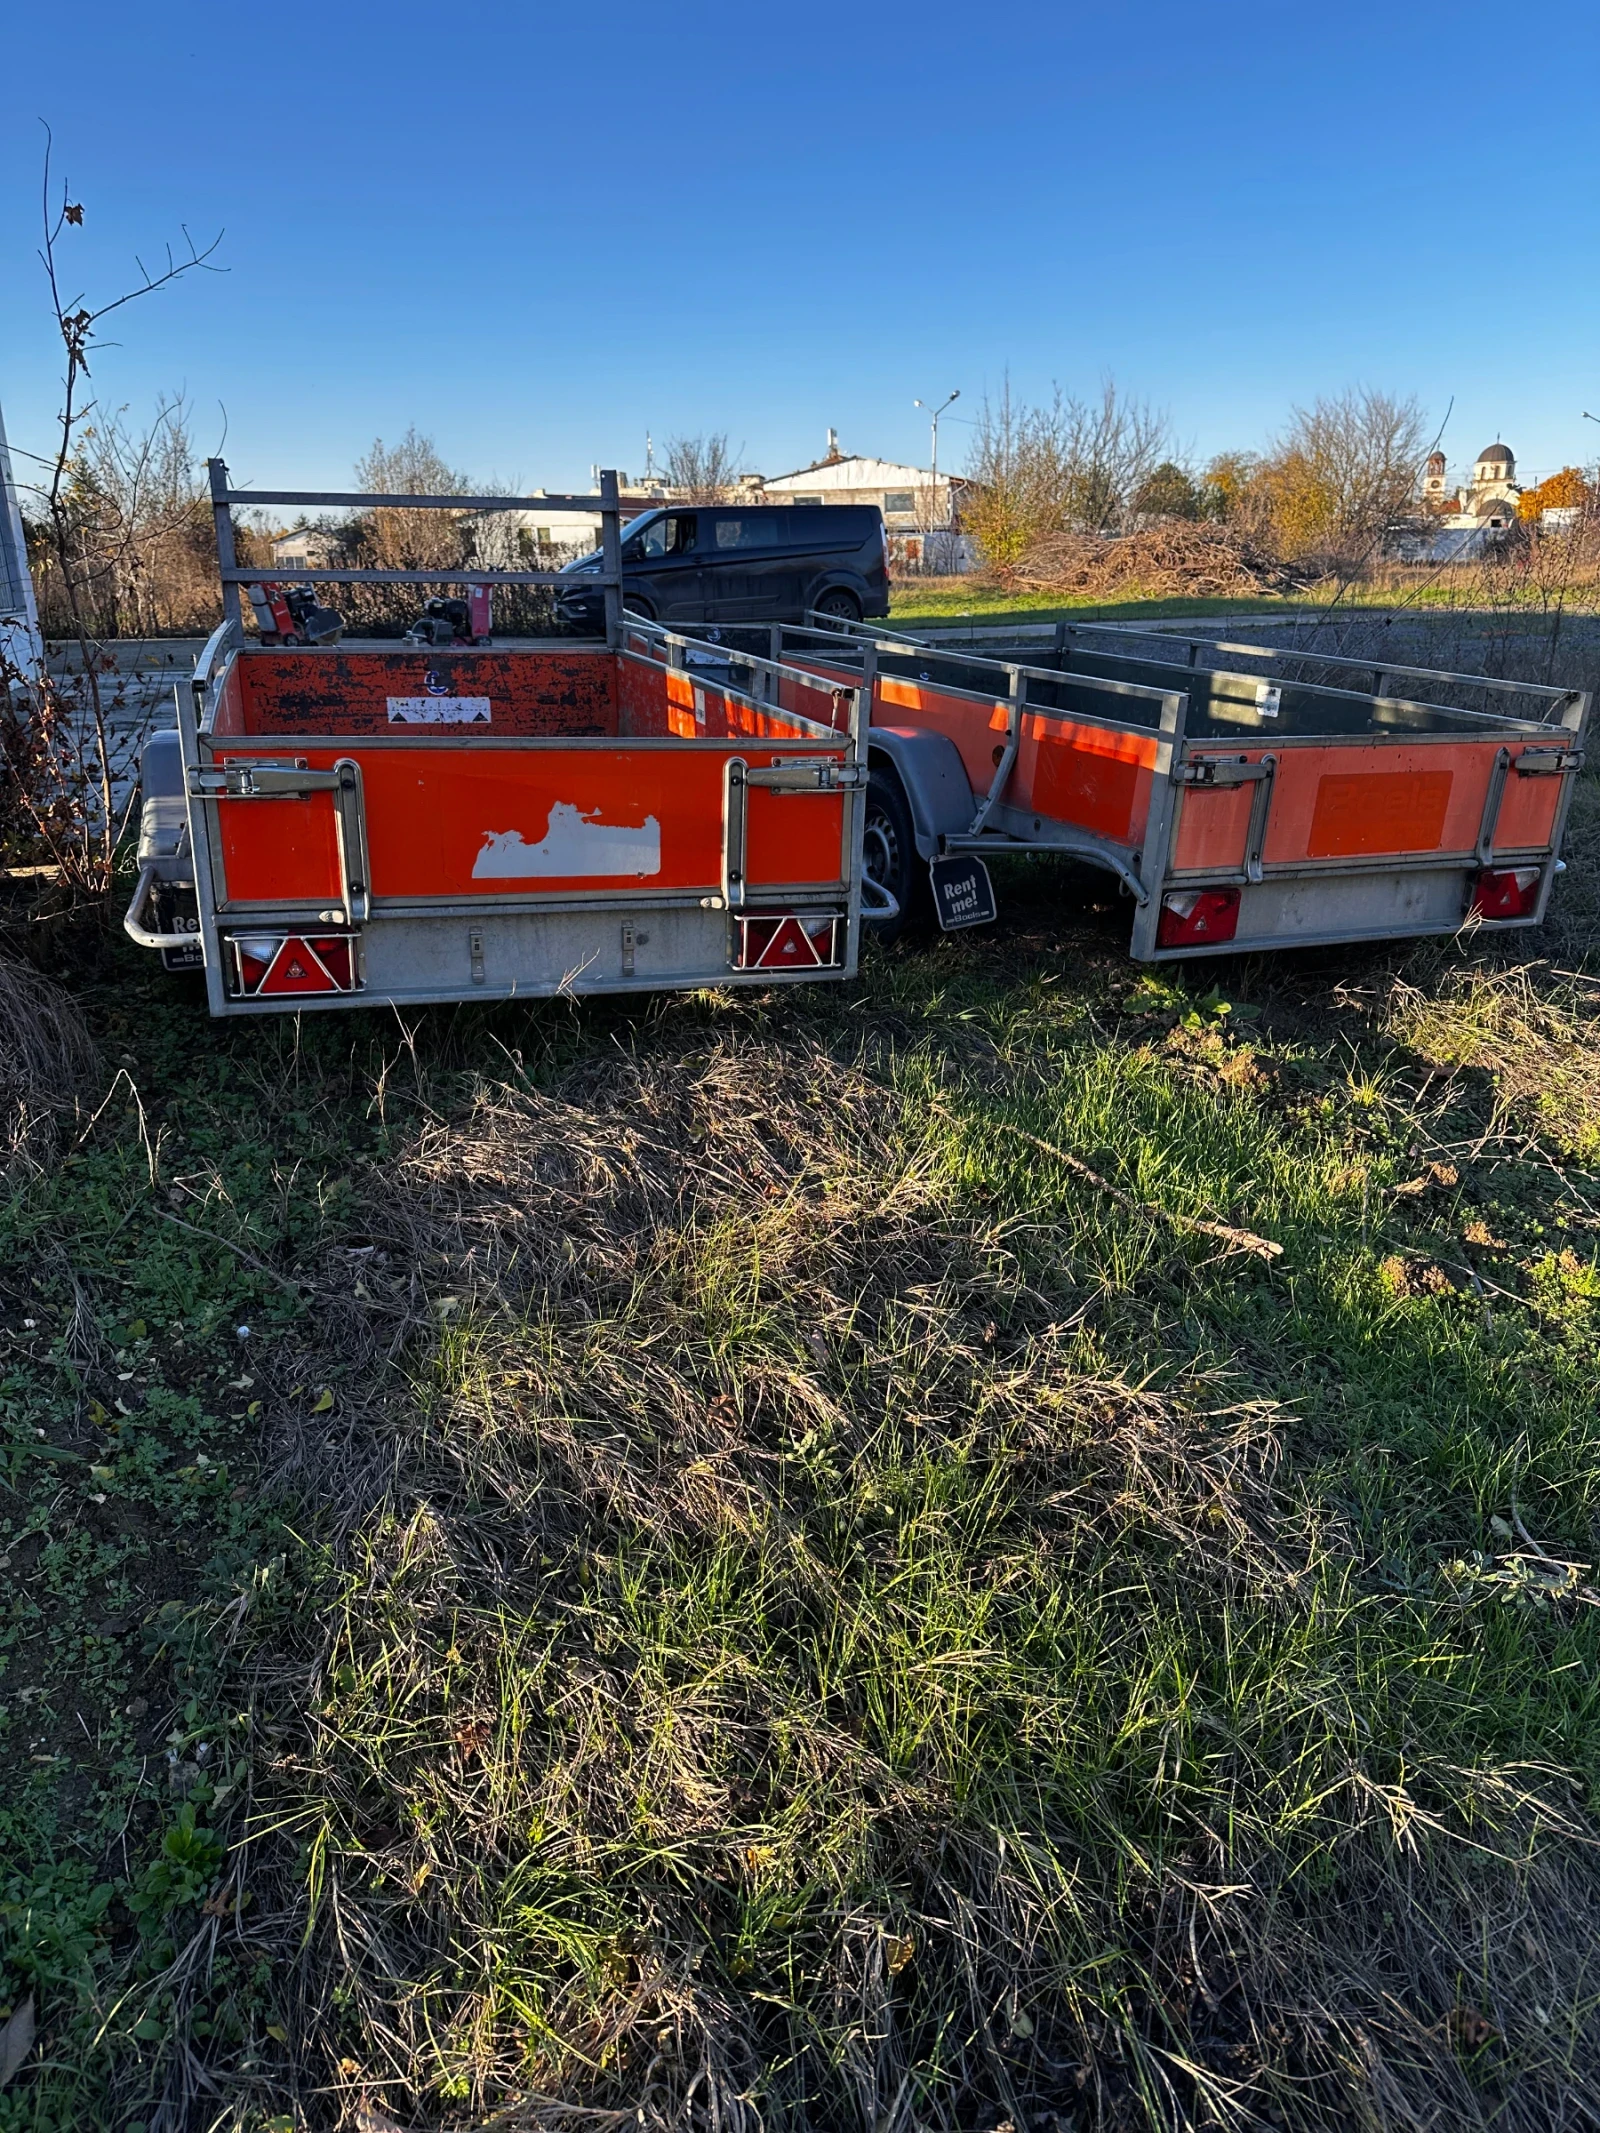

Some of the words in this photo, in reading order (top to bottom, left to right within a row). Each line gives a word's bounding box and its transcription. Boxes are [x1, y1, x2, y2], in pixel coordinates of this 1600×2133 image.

[943, 874, 977, 900] Rent
[951, 889, 978, 915] me!
[172, 916, 199, 934] Re
